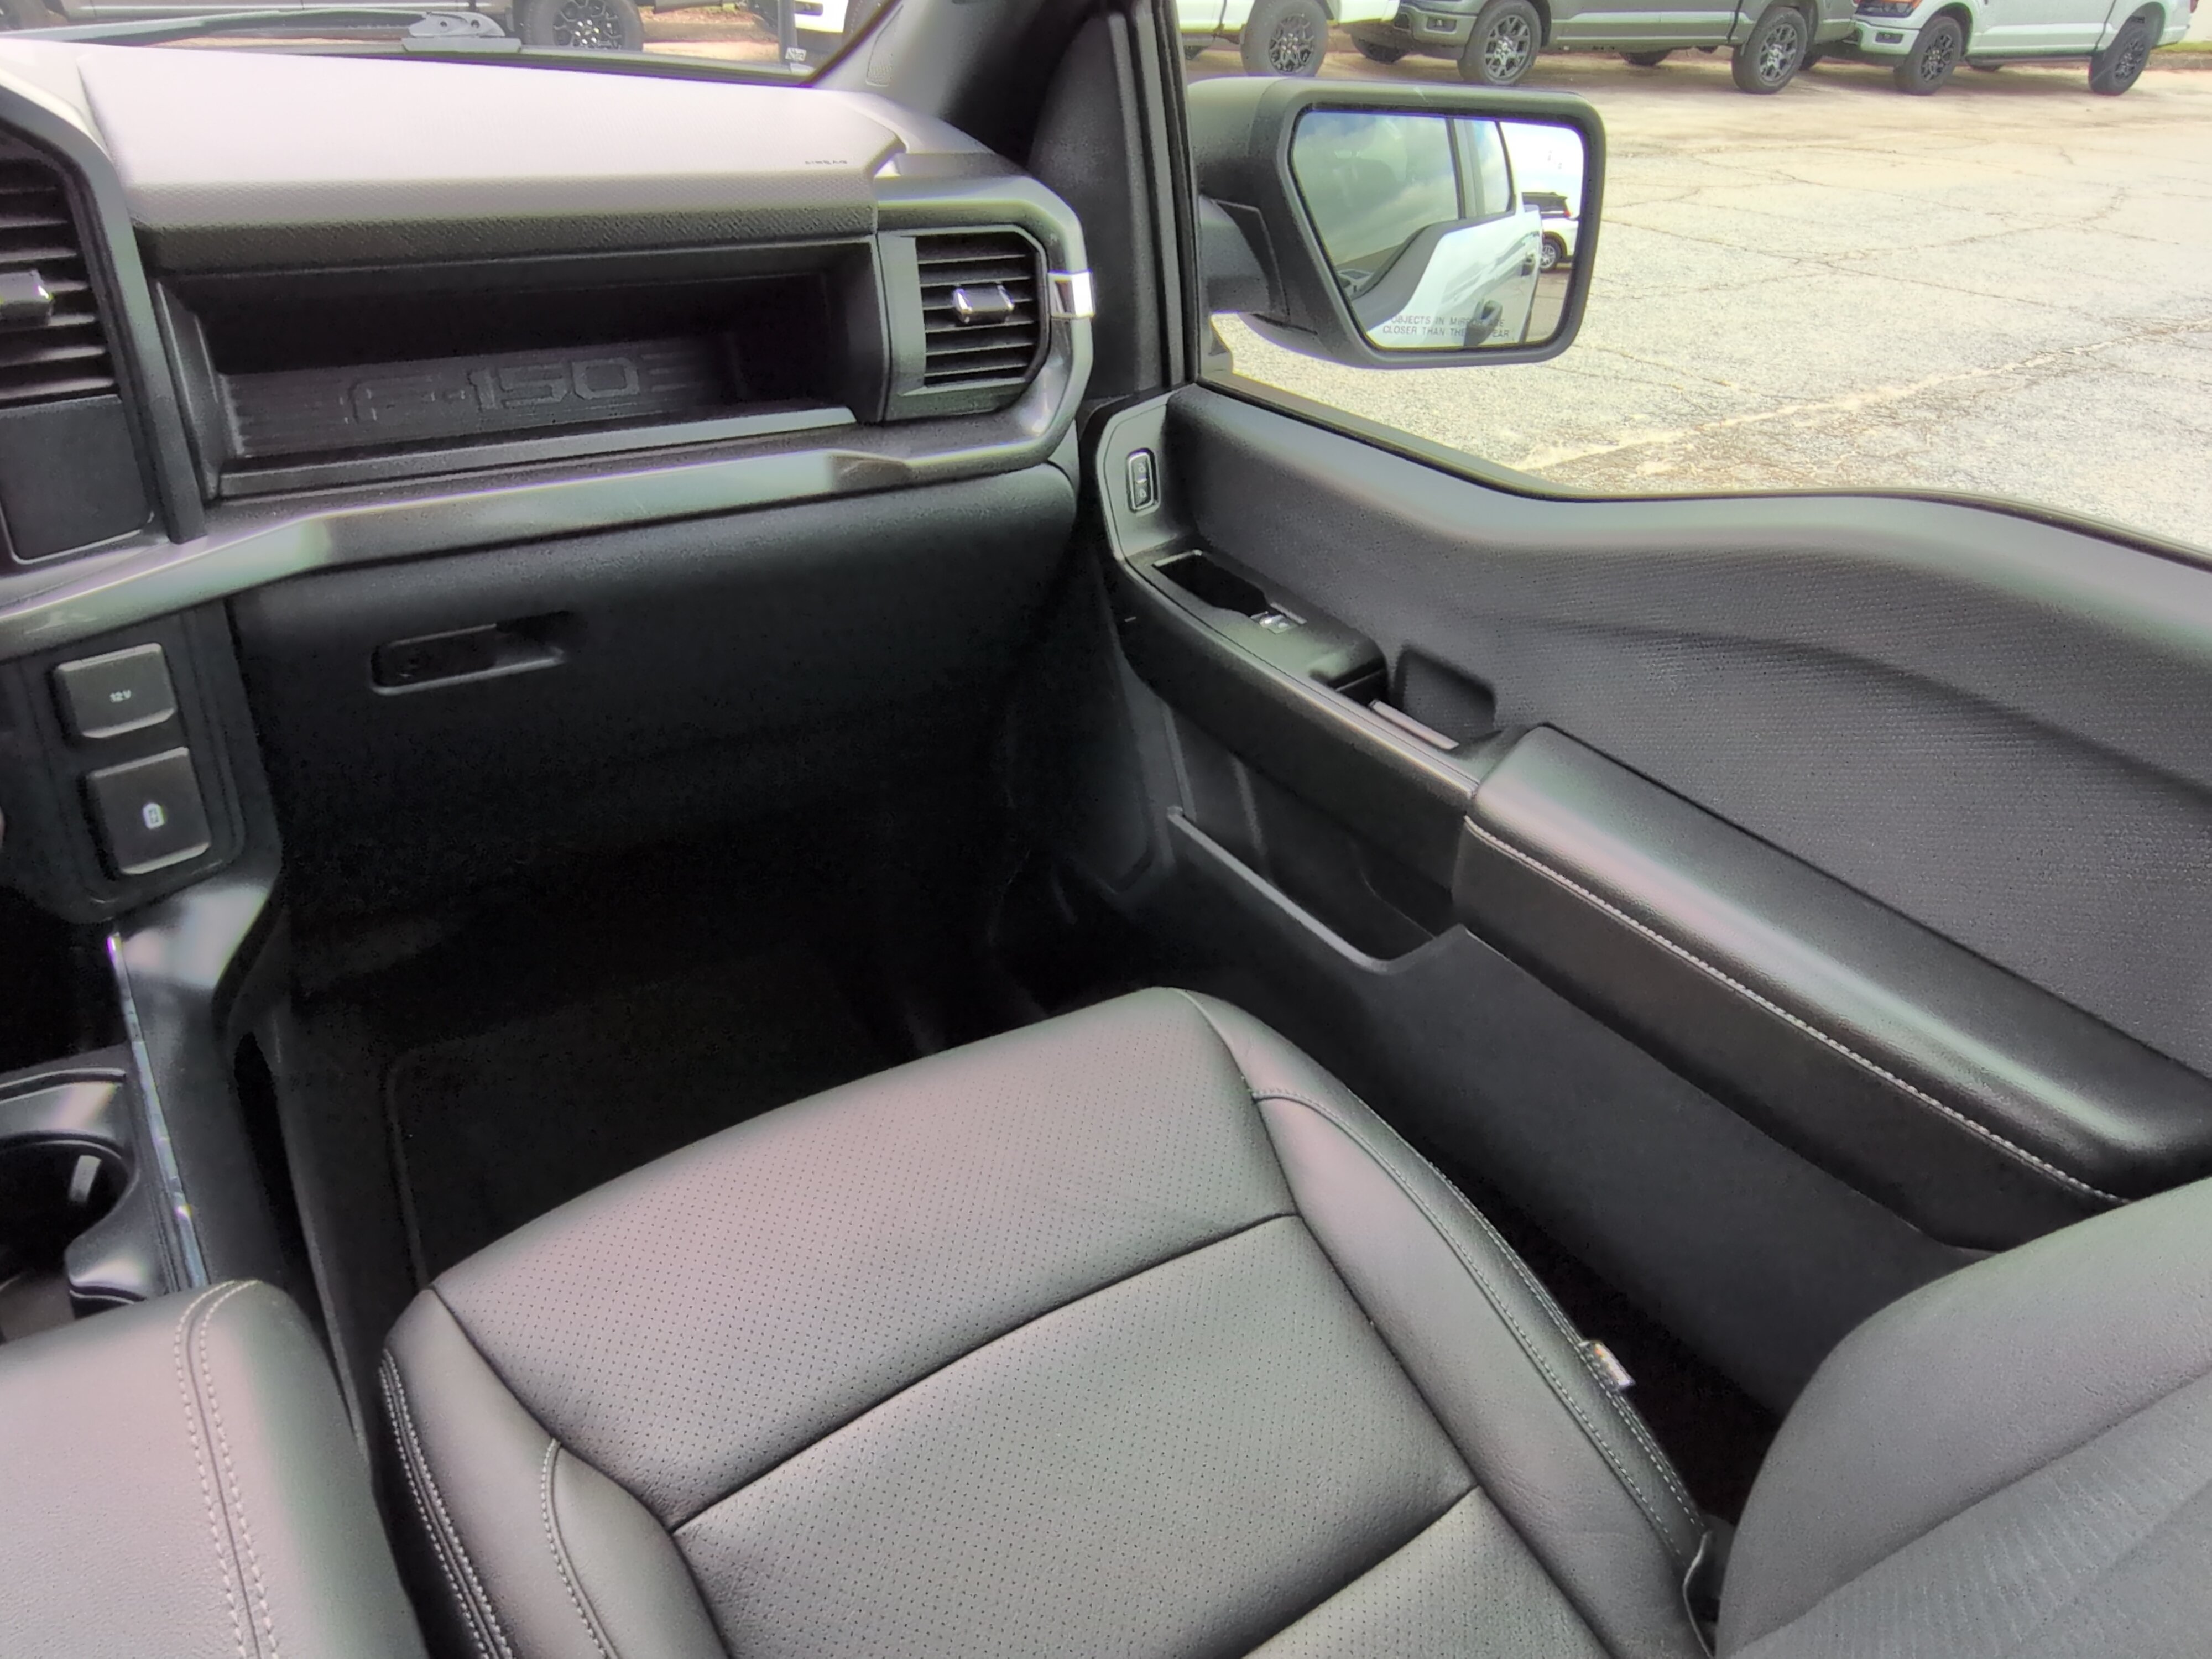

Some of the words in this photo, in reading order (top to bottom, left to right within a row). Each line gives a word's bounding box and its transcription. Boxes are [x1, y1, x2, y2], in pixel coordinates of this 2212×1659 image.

[1391, 315, 1432, 325] OBJECTS
[1435, 317, 1445, 325] IN
[1383, 325, 1417, 335] CLOSER
[1422, 327, 1445, 336] THAN
[1450, 328, 1468, 337] THE
